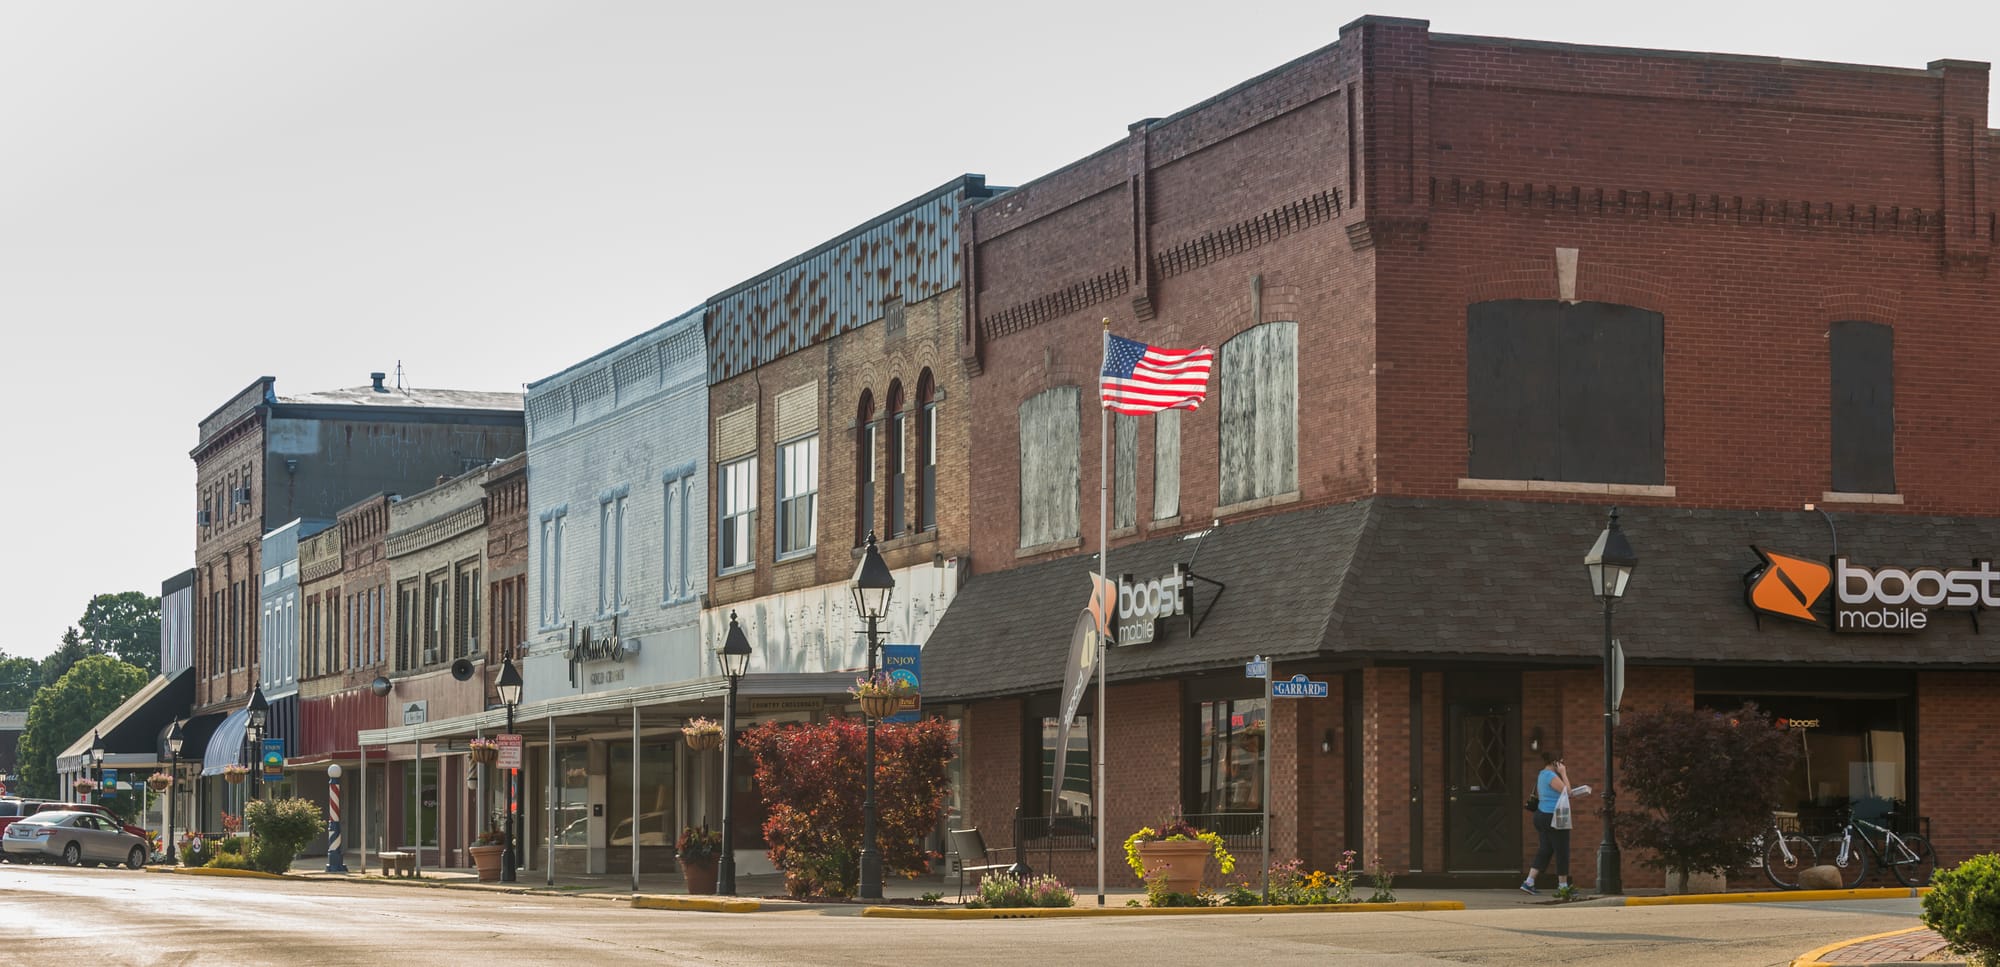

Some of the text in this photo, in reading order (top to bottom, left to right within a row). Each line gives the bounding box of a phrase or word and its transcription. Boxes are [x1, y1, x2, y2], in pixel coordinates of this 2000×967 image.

[1119, 563, 1185, 620] boost
[1838, 558, 2000, 607] boost
[1839, 607, 1927, 630] mobile
[1119, 619, 1154, 643] mobile
[565, 614, 625, 689] Hallmark
[887, 657, 916, 666] ENJOY
[1278, 683, 1320, 695] GARRARD
[1789, 718, 1820, 728] boost
